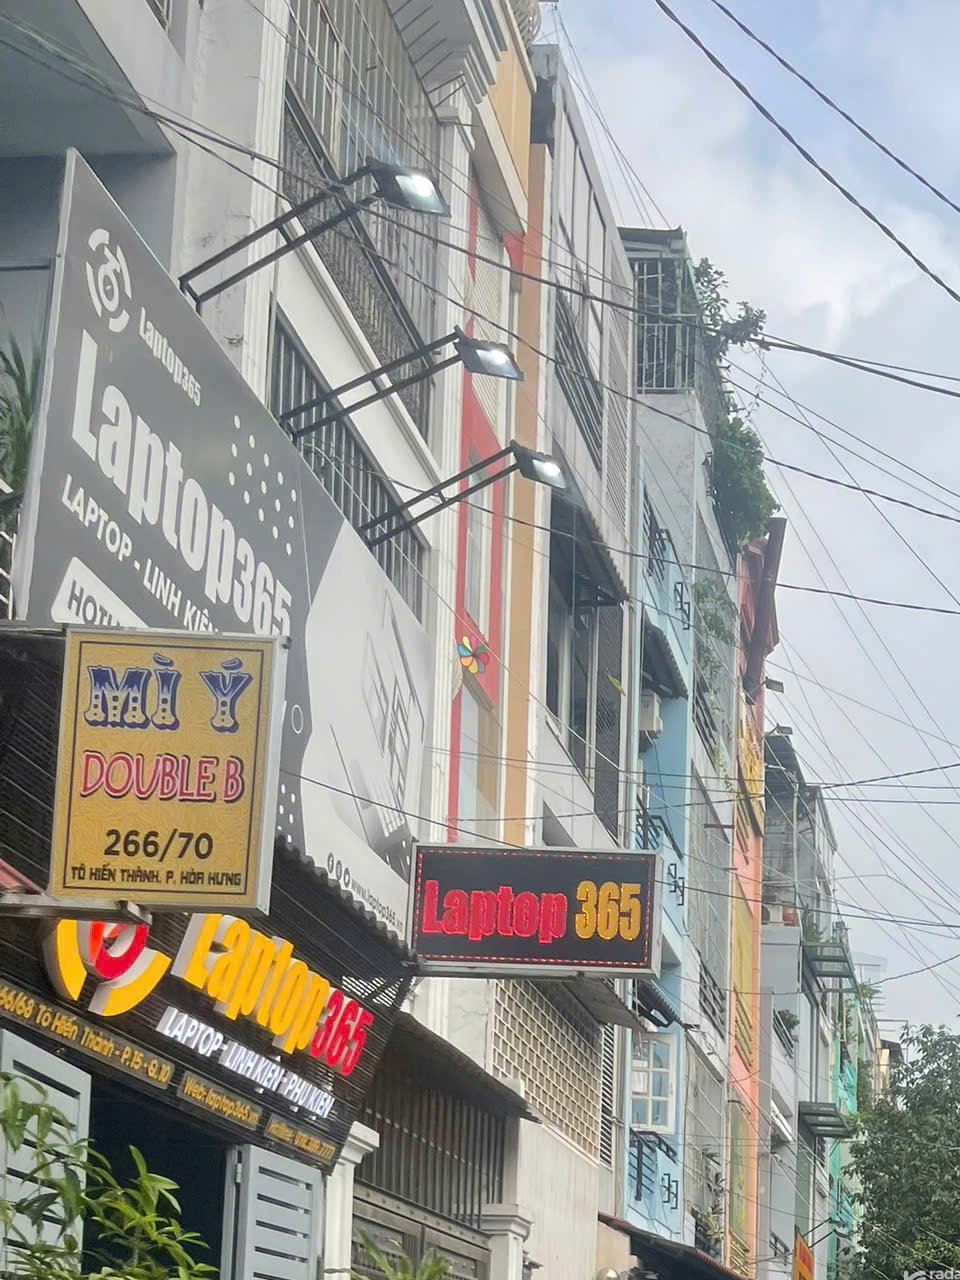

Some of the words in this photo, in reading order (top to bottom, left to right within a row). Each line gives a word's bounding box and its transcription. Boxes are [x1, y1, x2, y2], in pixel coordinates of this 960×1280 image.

[139, 306, 201, 407] Laptop365
[72, 328, 292, 636] Laptop365
[62, 473, 133, 561] LAPTOP
[143, 558, 182, 618] LINH
[84, 652, 182, 731] MÌ
[199, 657, 253, 733] Ý
[80, 750, 219, 802] DOUBLE
[223, 755, 244, 803] B
[71, 863, 86, 880] TÔ
[89, 862, 116, 882] HIẾN
[180, 867, 204, 885] HÒA
[207, 872, 241, 887] HƯNG
[104, 828, 214, 862] 266/70
[422, 880, 568, 944] Laptop
[575, 880, 641, 941] 365
[173, 912, 375, 1076] Laptop365
[159, 1007, 225, 1058] LAPTOP
[221, 1041, 258, 1079] LINH
